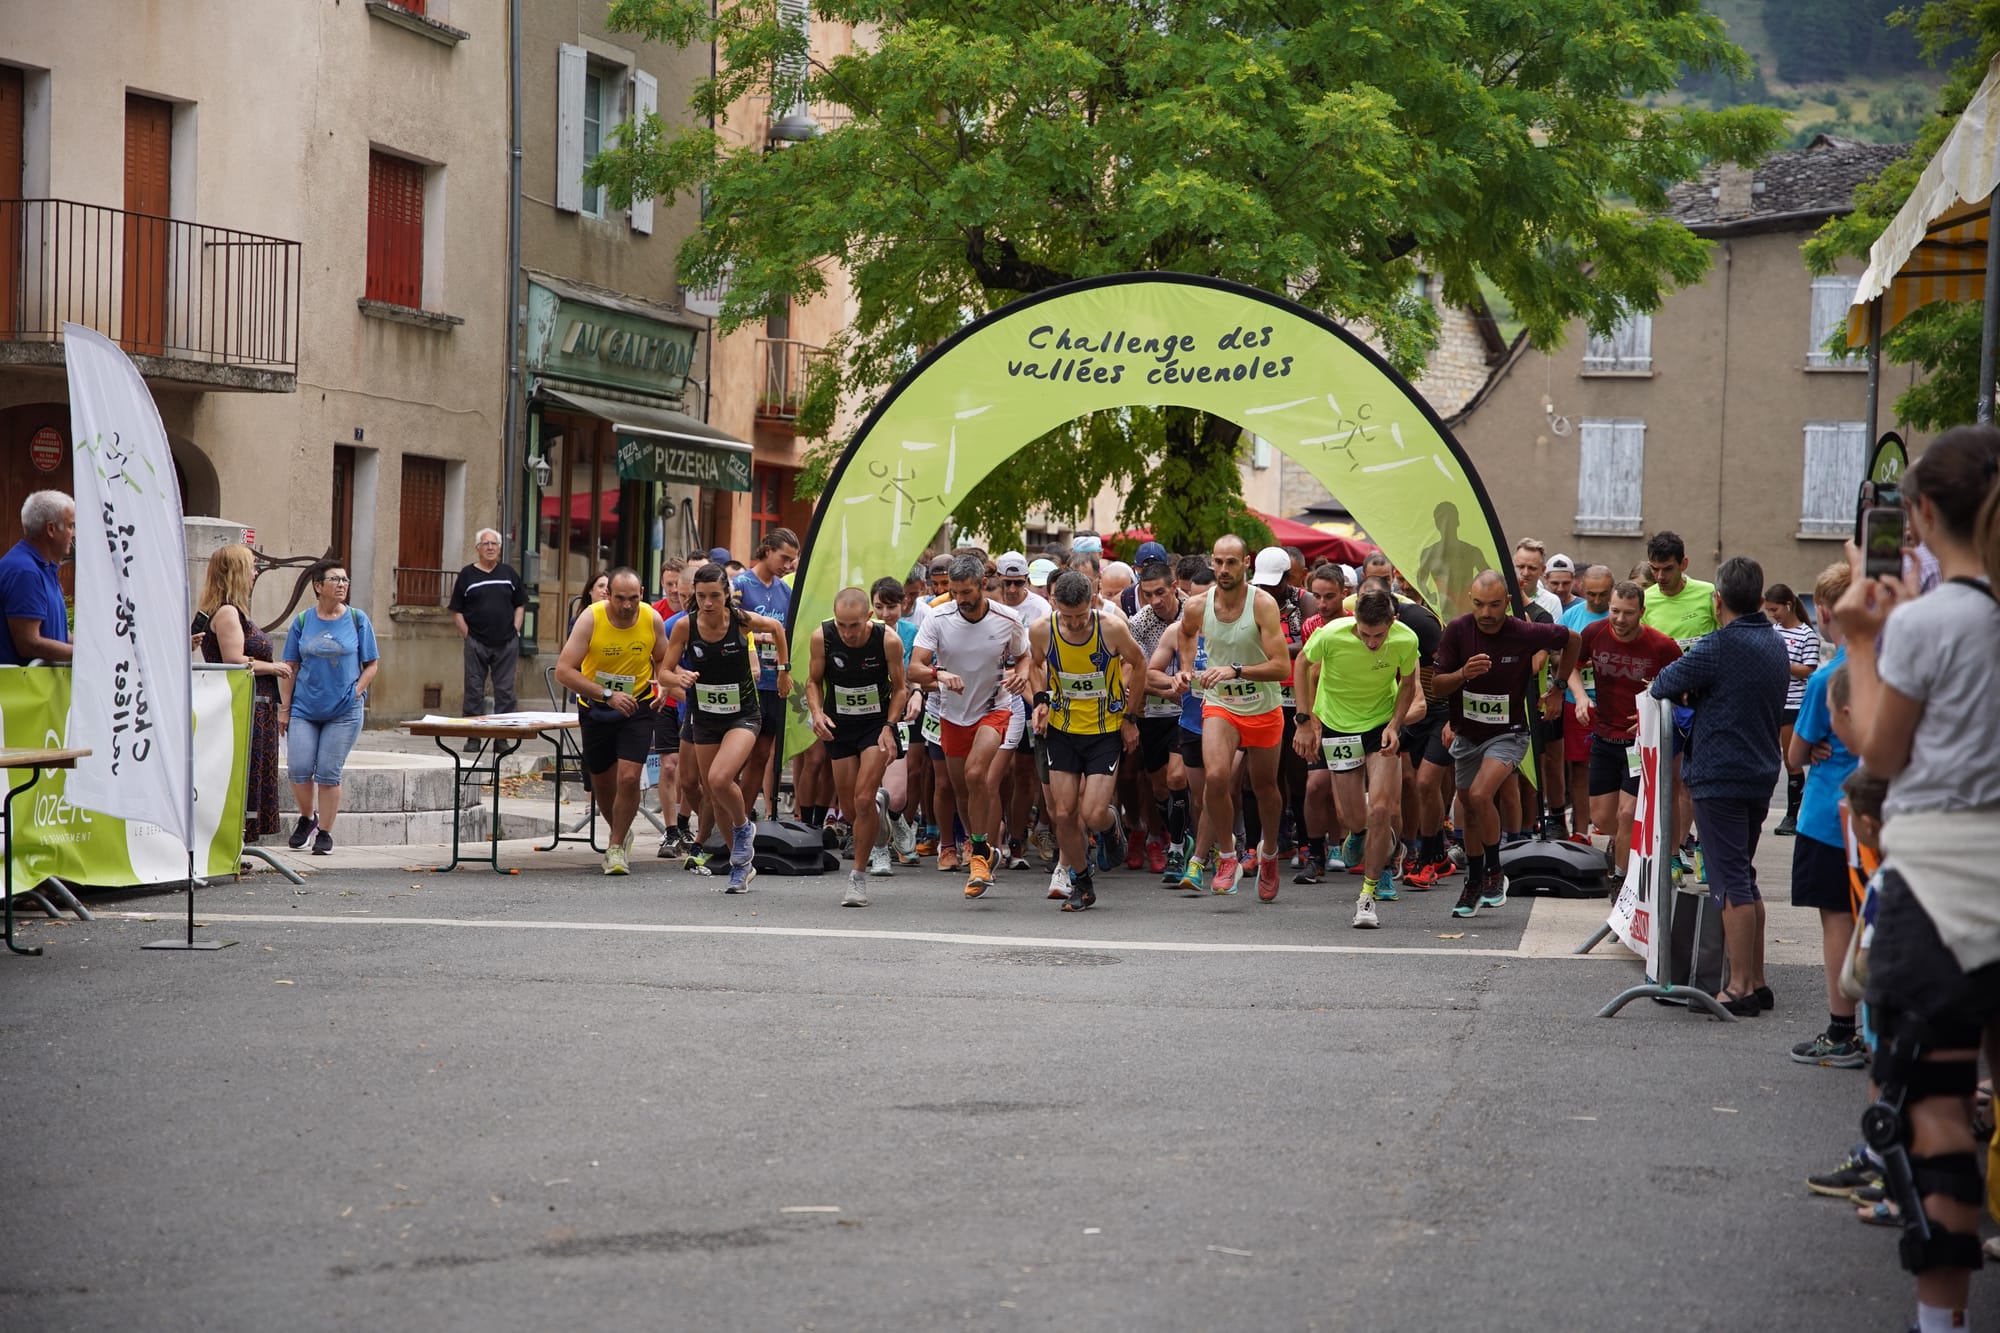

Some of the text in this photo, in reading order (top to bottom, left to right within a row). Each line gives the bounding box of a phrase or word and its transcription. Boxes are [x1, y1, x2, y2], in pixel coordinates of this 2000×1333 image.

[562, 322, 601, 356] AU
[1028, 325, 1273, 363] Challenge des
[1008, 356, 1294, 384] vallées cévenoles
[618, 441, 638, 463] PIZZA
[655, 446, 719, 480] PIZZERIA
[605, 680, 624, 691] 15
[1071, 680, 1094, 691] 48
[1224, 682, 1257, 696] 115
[707, 692, 729, 705] 56
[846, 694, 868, 706] 55
[1469, 700, 1503, 714] 104
[925, 718, 940, 733] 27
[1333, 745, 1353, 759] 43
